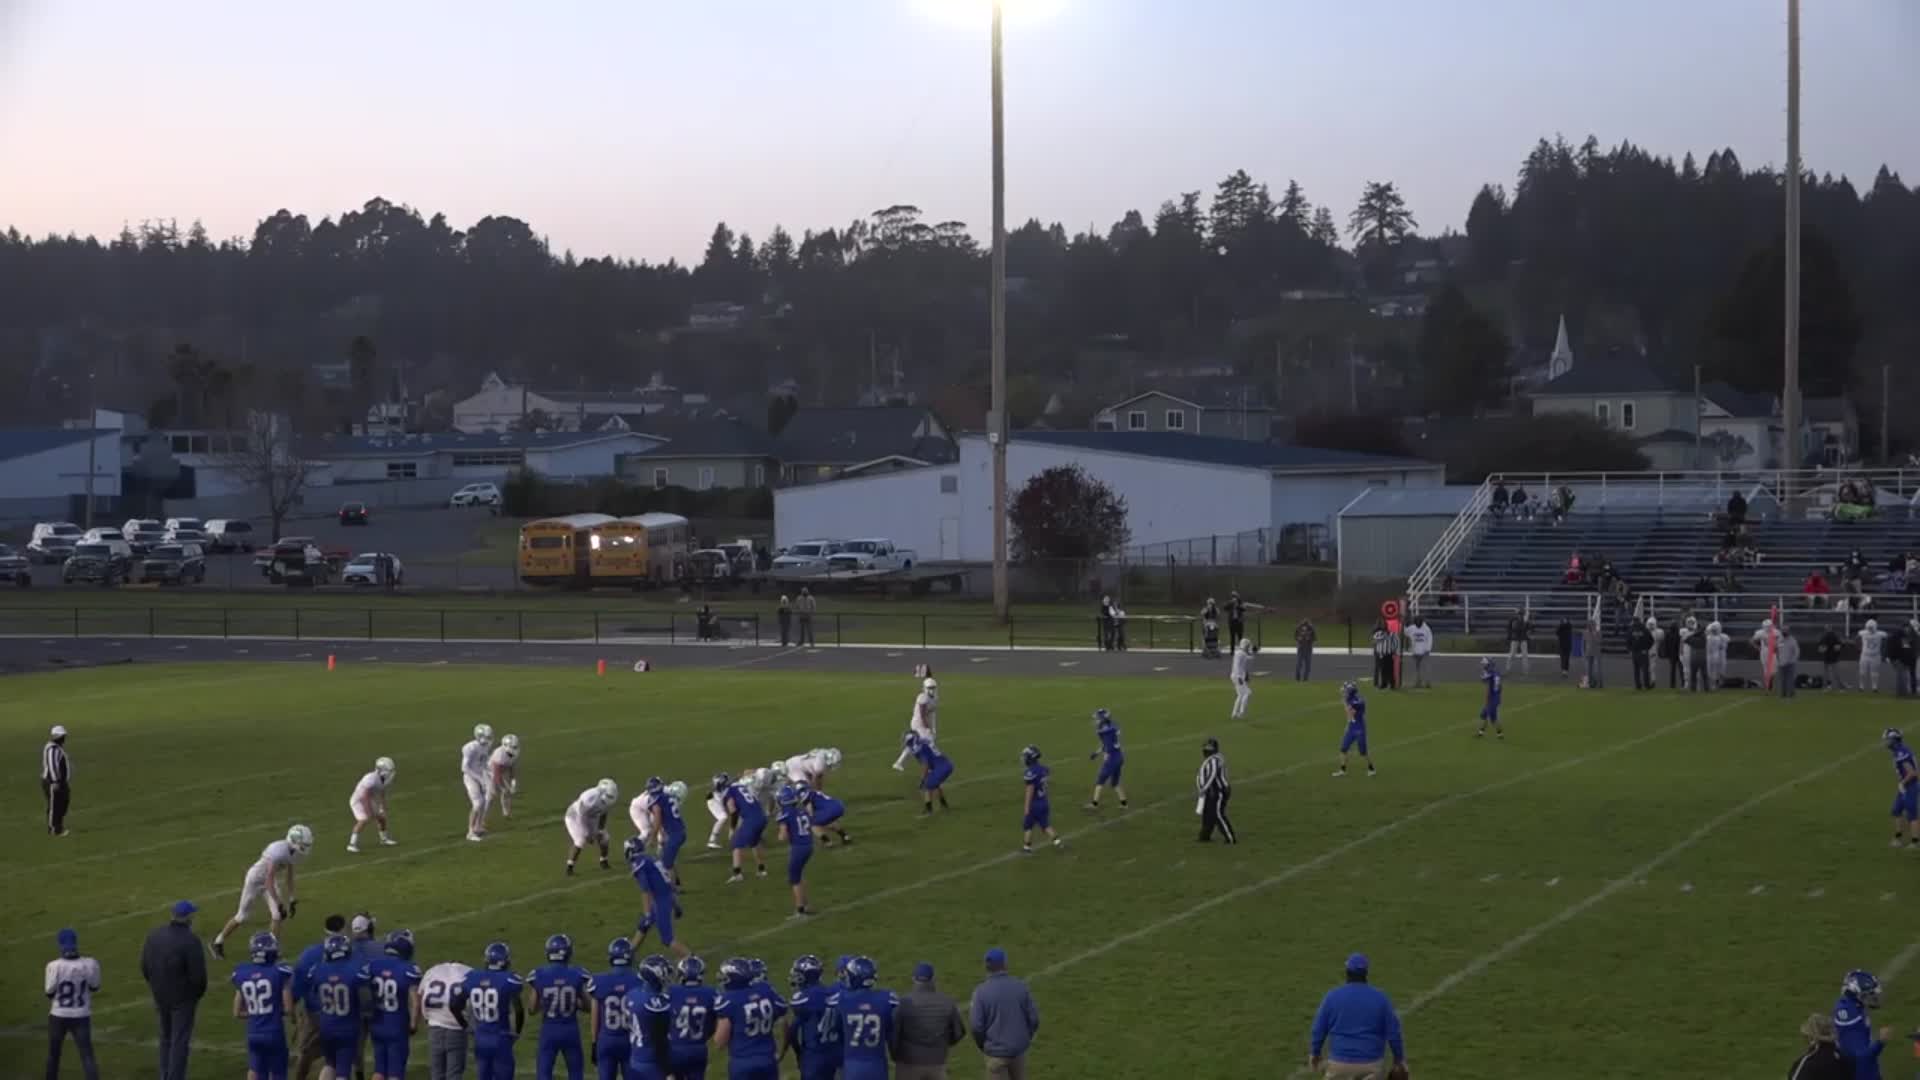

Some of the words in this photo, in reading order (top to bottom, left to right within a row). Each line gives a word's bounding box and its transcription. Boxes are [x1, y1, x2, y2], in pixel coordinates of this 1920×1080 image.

[797, 816, 810, 836] 12
[241, 979, 273, 1015] 82
[470, 987, 499, 1022] 88
[543, 986, 577, 1018] 70
[676, 1005, 707, 1039] 43
[744, 998, 773, 1036] 58
[847, 1014, 880, 1047] 73
